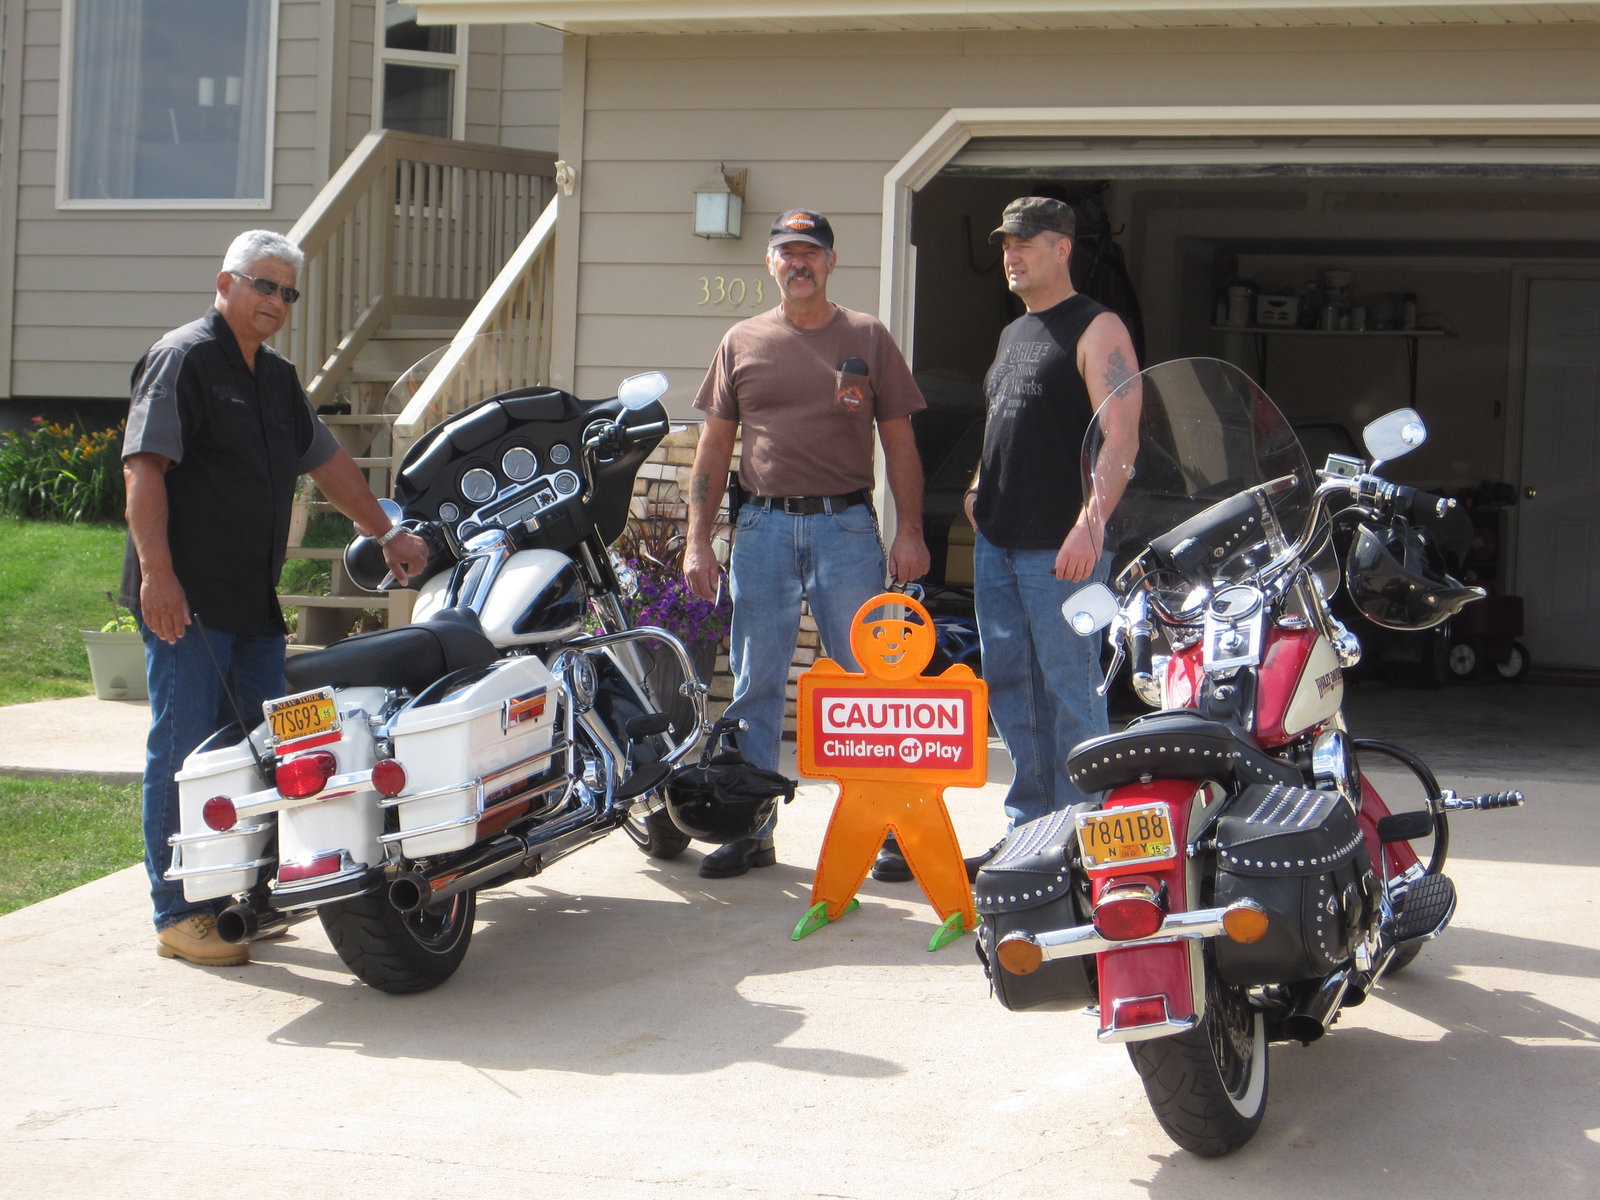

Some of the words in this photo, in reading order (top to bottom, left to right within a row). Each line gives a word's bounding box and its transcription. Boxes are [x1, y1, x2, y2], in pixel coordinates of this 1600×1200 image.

[697, 276, 764, 308] 3303
[1011, 378, 1043, 396] Works
[277, 699, 298, 710] NEW
[299, 693, 320, 704] YORK
[269, 705, 321, 737] 27SG93
[828, 703, 958, 729] CAUTION
[823, 740, 895, 757] Children
[901, 742, 920, 756] at
[925, 742, 963, 763] Play
[1087, 815, 1163, 846] 7841B8
[1109, 848, 1117, 856] N
[1140, 843, 1148, 853] Y
[1151, 845, 1160, 854] 15
